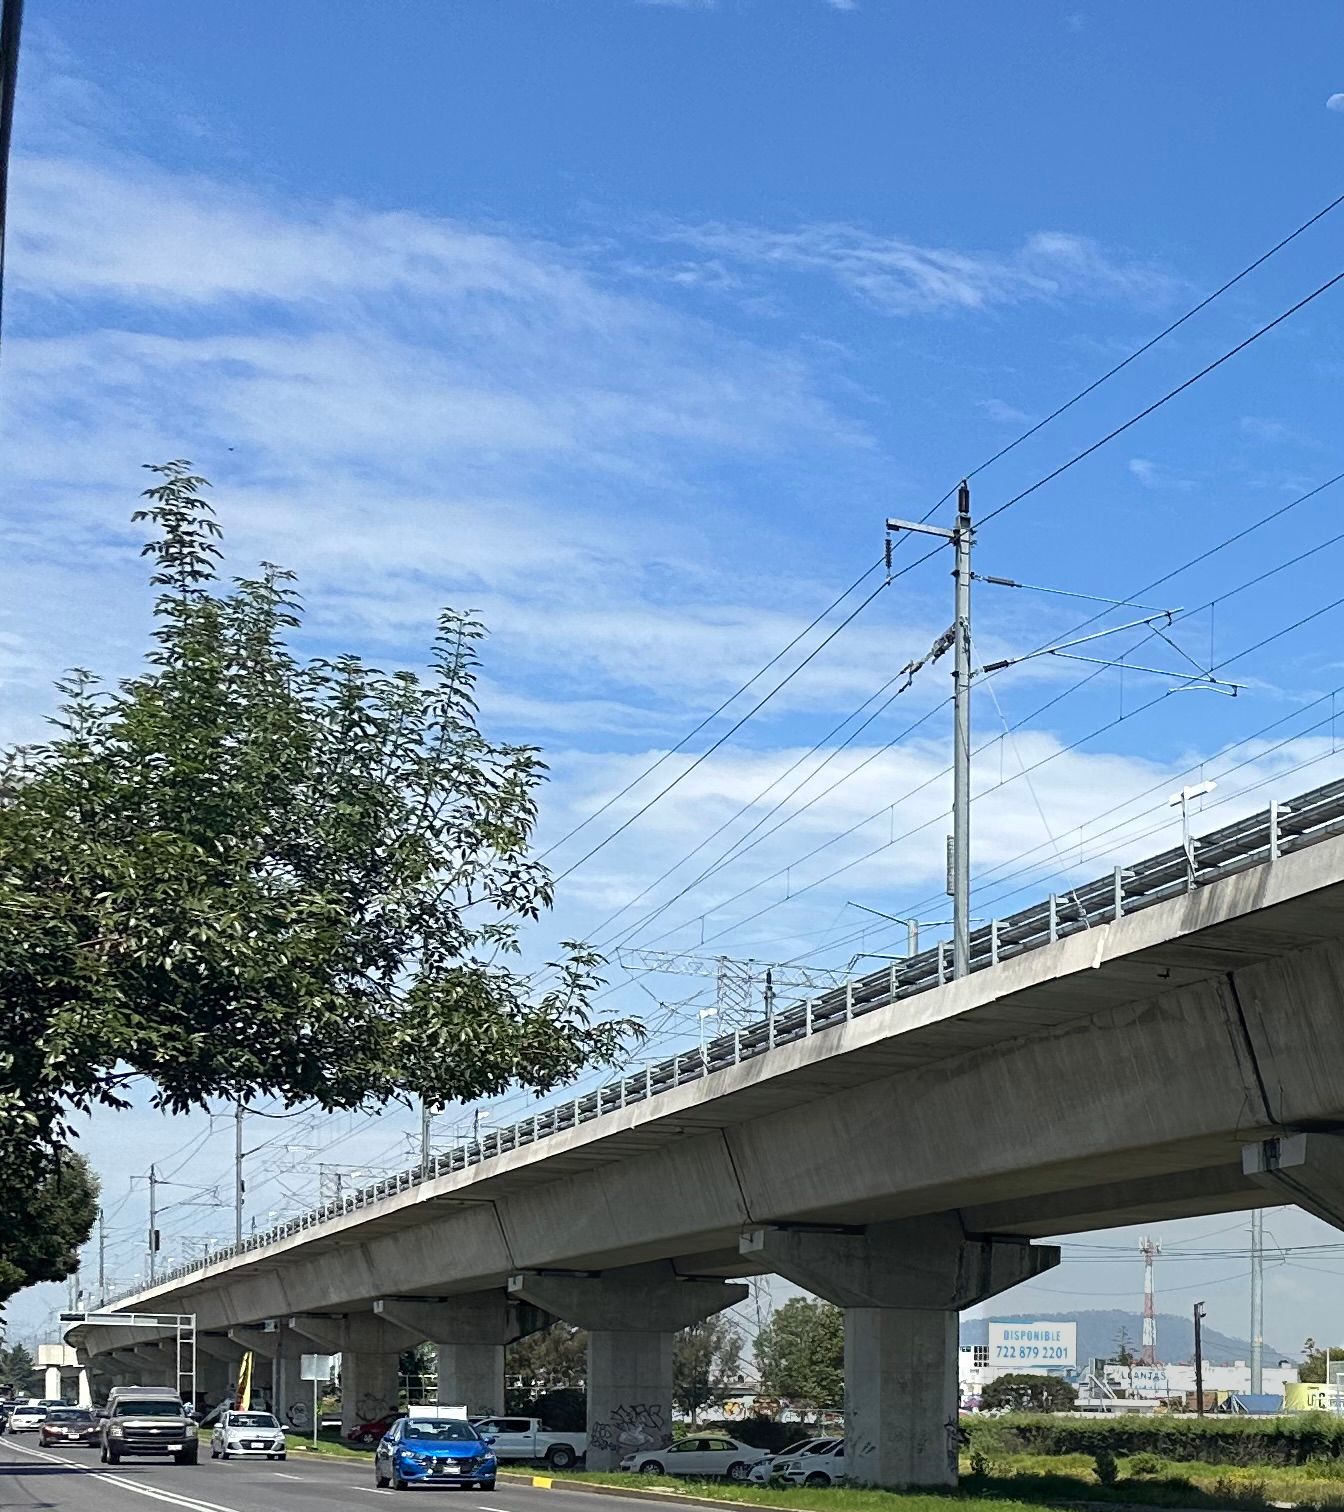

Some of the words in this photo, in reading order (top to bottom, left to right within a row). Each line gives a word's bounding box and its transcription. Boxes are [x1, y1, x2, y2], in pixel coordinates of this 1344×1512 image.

[1003, 1330, 1061, 1342] DISPONIBLE
[996, 1345, 1016, 1359] 722
[1019, 1346, 1039, 1359] 879
[1042, 1346, 1068, 1360] 2201
